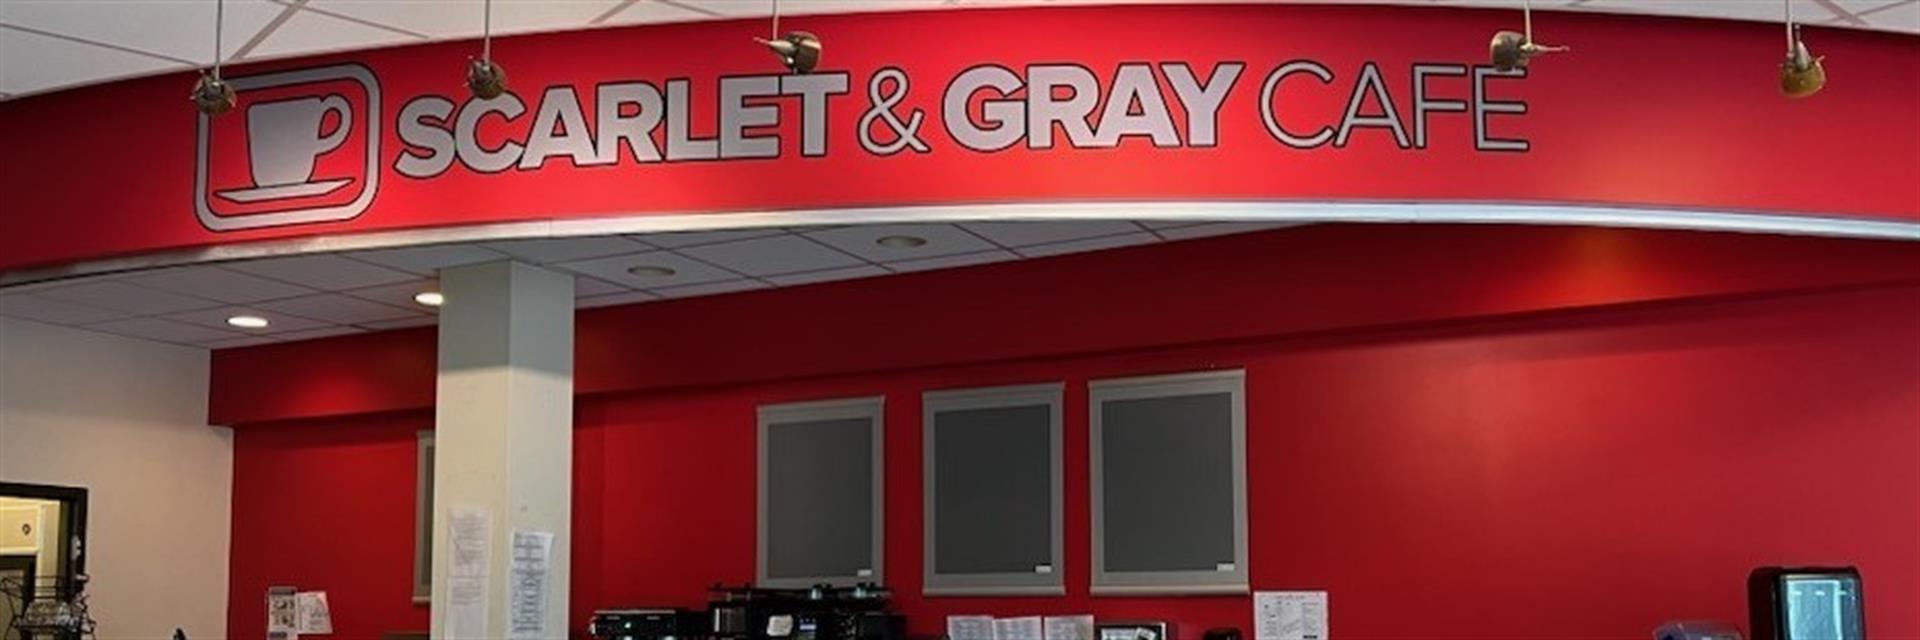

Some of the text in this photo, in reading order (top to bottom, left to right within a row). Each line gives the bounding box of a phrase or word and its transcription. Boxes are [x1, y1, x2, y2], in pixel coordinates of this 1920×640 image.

[394, 72, 850, 178] SCARLET
[857, 66, 931, 157] &
[942, 62, 1243, 152] GRAY
